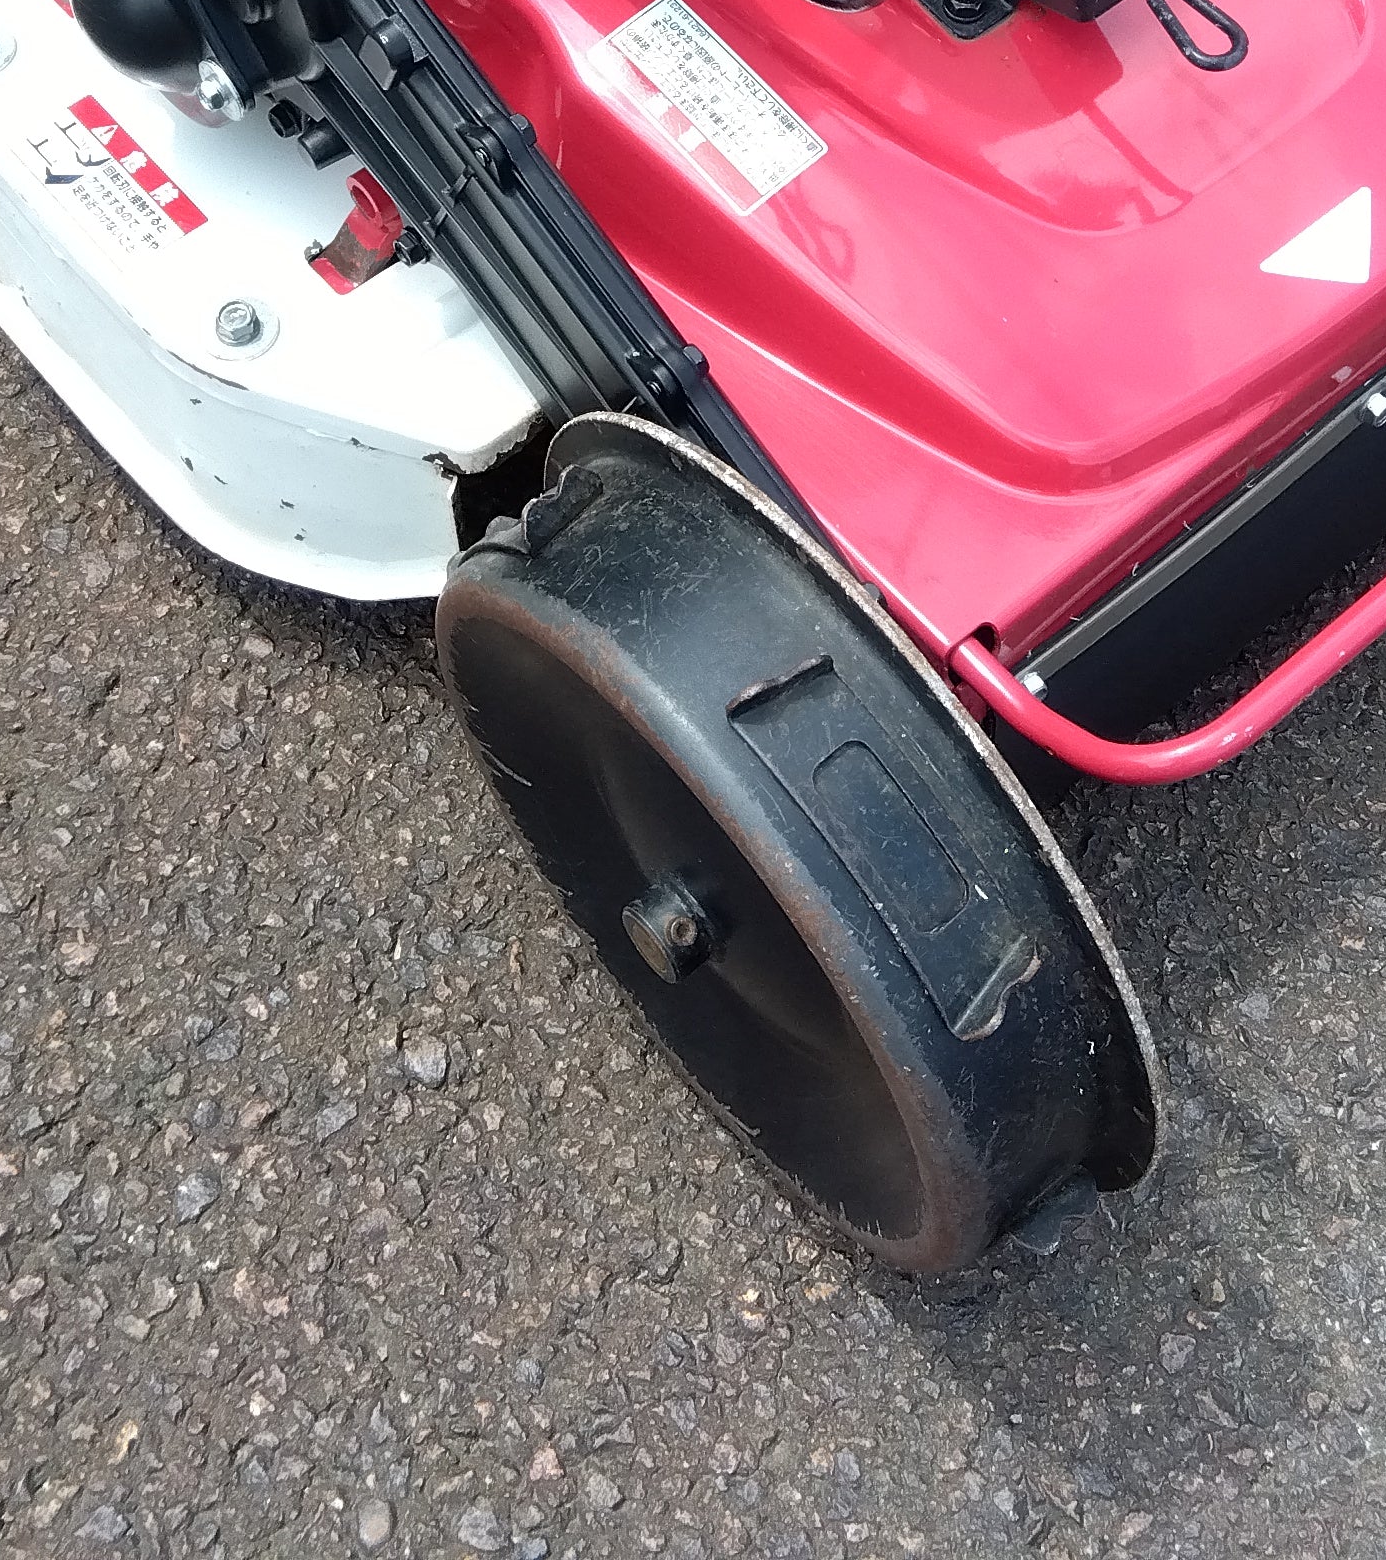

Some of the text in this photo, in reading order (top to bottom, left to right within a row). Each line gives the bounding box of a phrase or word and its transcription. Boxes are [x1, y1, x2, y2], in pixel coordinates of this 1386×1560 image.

[101, 164, 171, 234] 回転刃に接触すると
